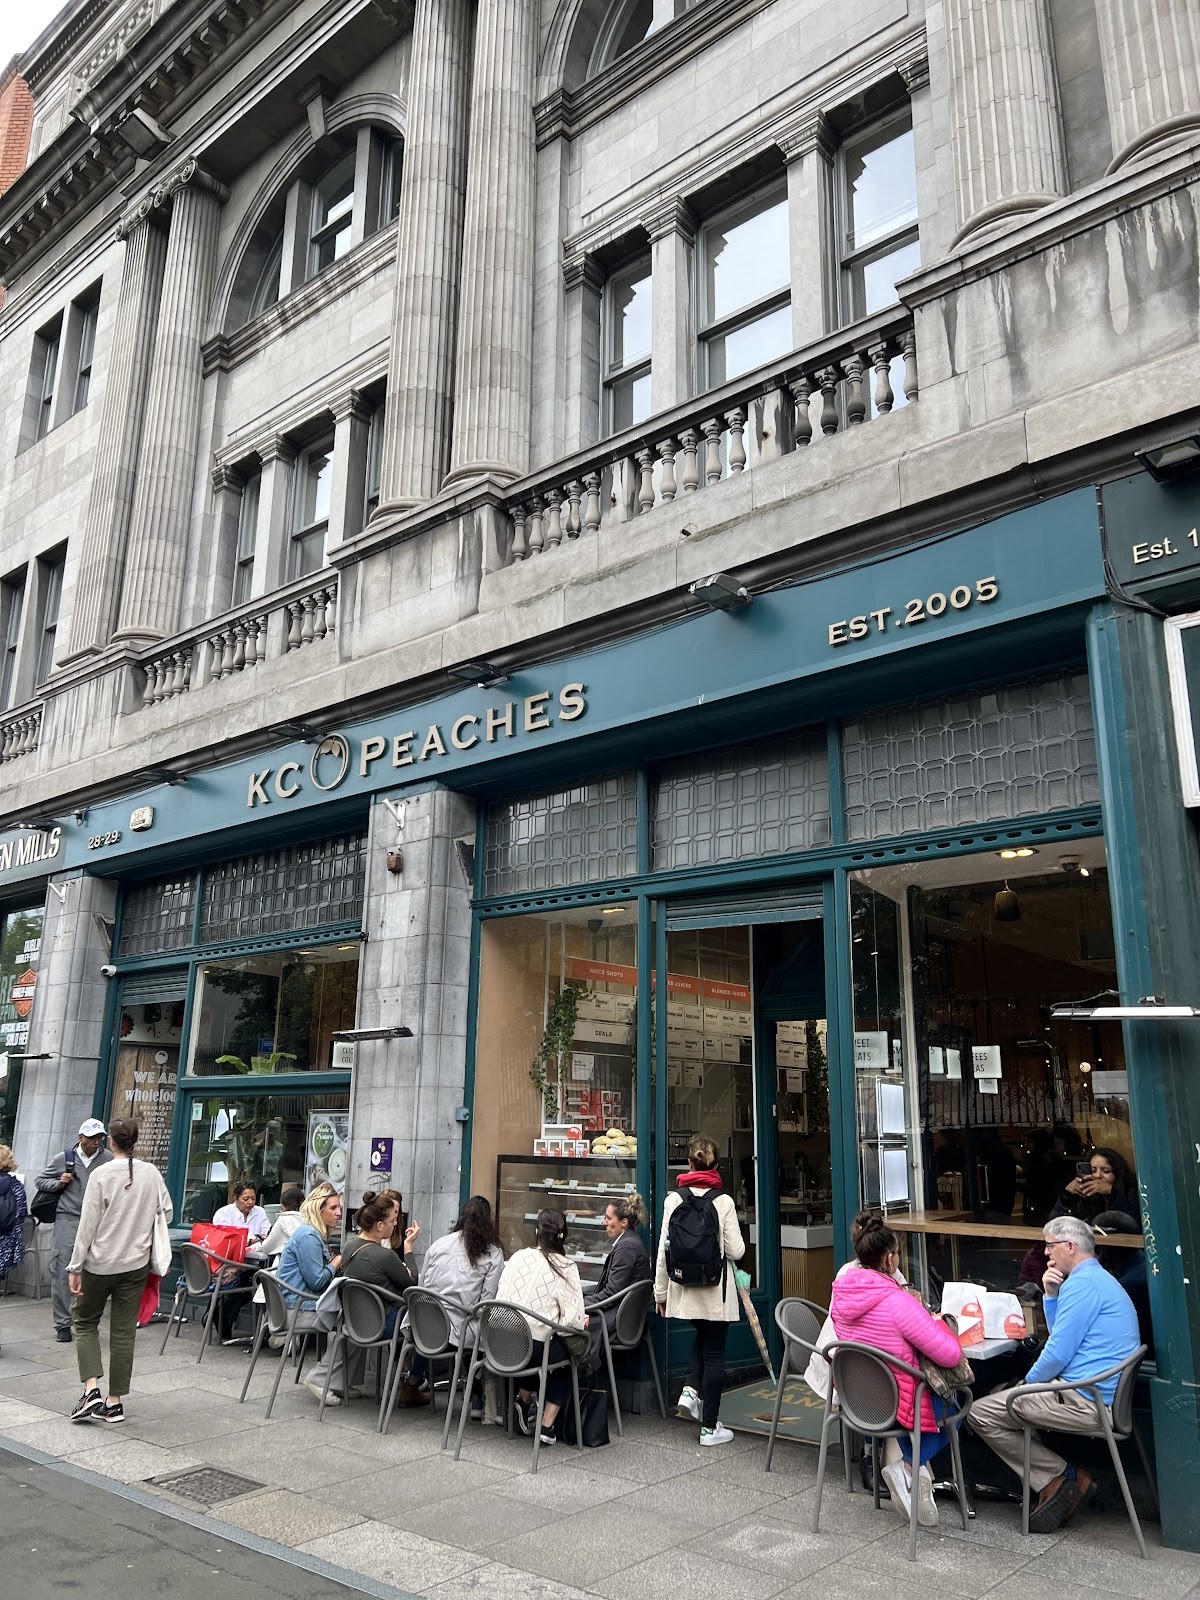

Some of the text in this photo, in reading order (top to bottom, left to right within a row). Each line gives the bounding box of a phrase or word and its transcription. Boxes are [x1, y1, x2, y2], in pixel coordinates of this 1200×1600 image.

[1132, 536, 1178, 564] Est.
[359, 682, 586, 777] PEACHES
[87, 830, 119, 849] 28-29
[15, 827, 61, 867] MILLS
[606, 970, 624, 978] SHOTS
[675, 981, 692, 989] JUICES
[711, 988, 731, 996] BLENDED
[855, 1038, 870, 1048] EET
[855, 1052, 872, 1061] ATS
[134, 1071, 155, 1084] WE
